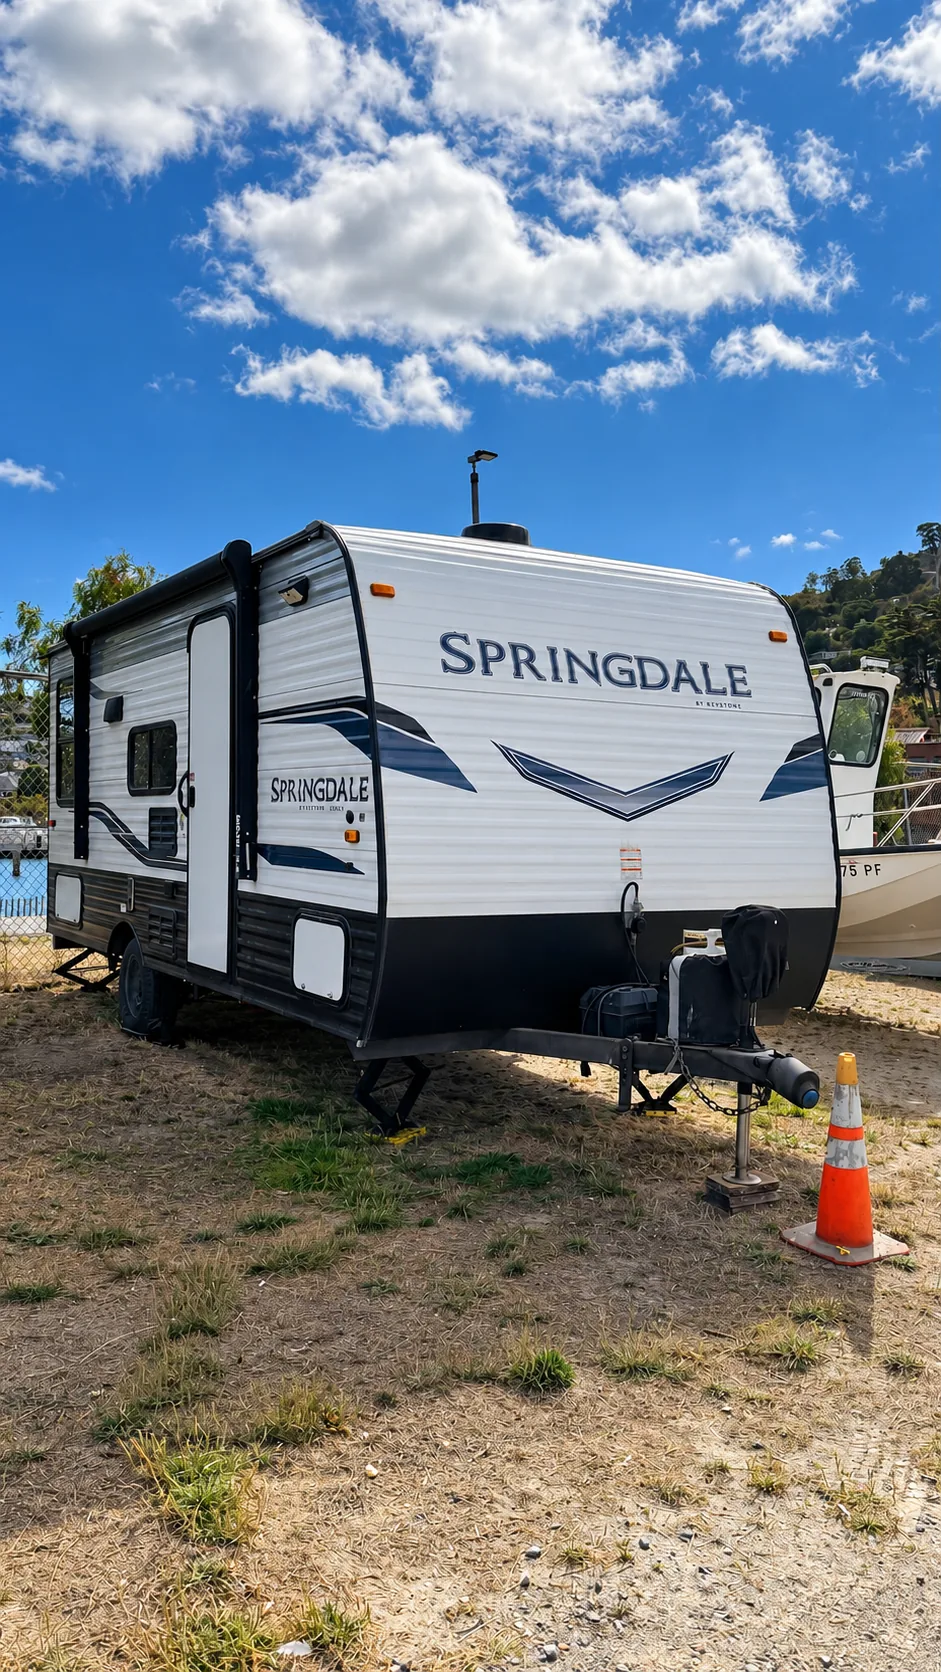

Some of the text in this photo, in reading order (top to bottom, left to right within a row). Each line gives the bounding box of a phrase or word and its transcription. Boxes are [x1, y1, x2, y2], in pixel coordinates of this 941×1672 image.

[439, 631, 752, 698] SPRINGDALE
[270, 776, 369, 802] SPRINGDALE
[840, 863, 881, 877] 75 PF
